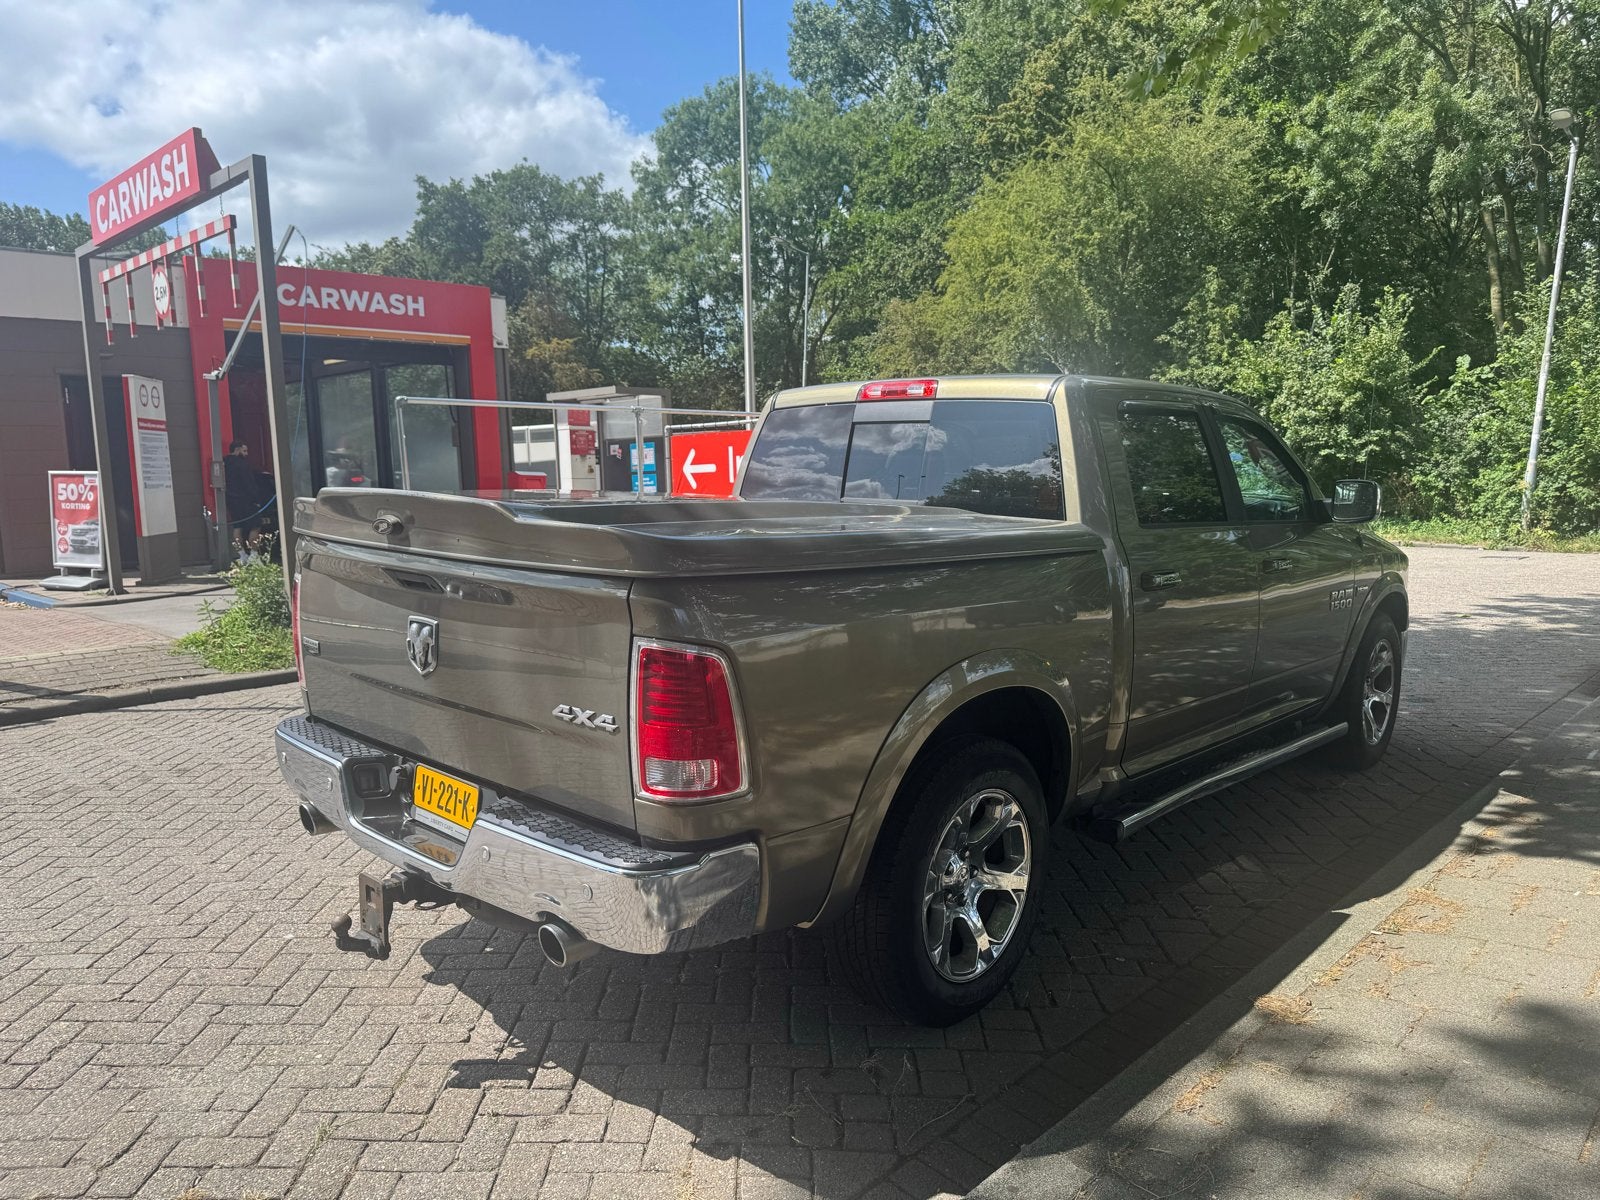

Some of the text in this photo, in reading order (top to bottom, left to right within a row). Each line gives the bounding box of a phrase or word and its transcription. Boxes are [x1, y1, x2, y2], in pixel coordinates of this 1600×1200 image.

[96, 143, 190, 234] CARWASH
[277, 283, 426, 317] CARWASH
[57, 482, 94, 502] 50%
[61, 502, 91, 511] KORTING
[1331, 599, 1352, 611] 1500
[422, 773, 472, 823] VJ-221-K
